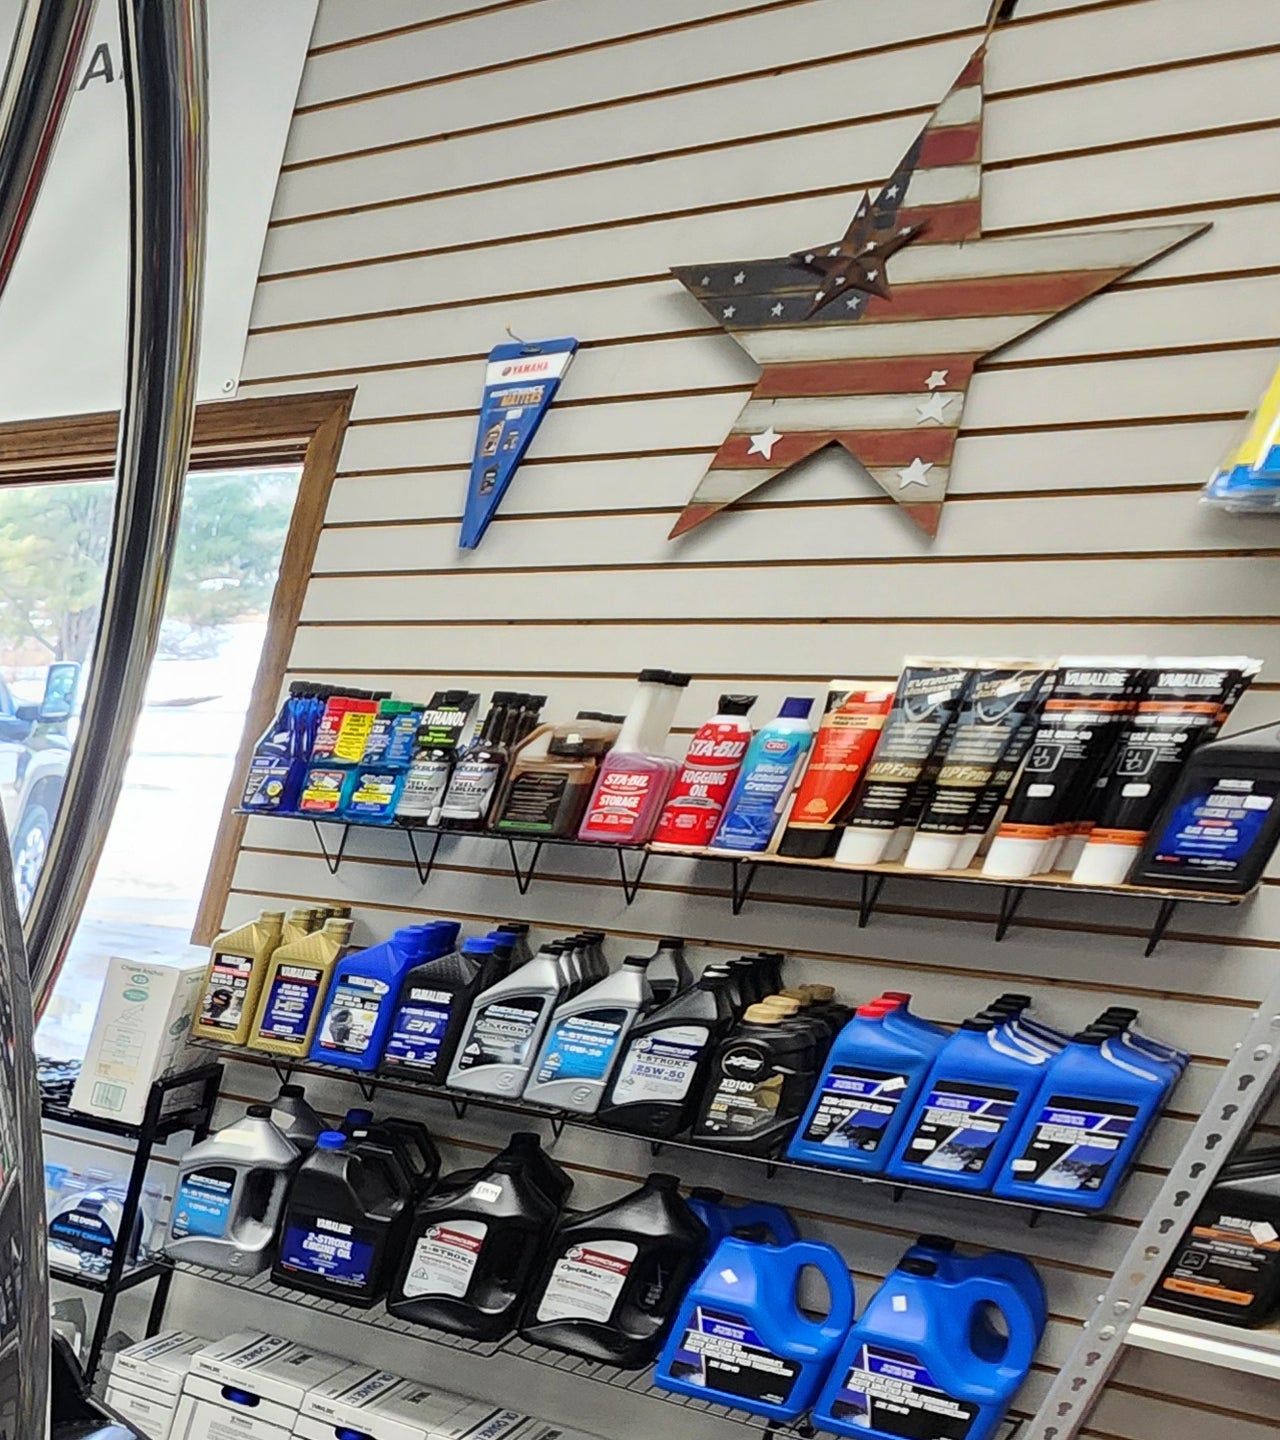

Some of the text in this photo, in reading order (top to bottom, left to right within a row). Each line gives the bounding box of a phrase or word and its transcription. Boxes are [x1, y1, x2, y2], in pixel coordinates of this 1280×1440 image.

[1064, 671, 1130, 687] YAMALUBE
[1157, 671, 1229, 688] YAMALUBE
[421, 710, 467, 727] ETHANOL
[688, 738, 746, 758] STA-BIL
[766, 741, 788, 750] CRC
[604, 773, 650, 788] STA-BIL
[681, 769, 728, 785] FOGGING
[689, 784, 709, 797] OIL
[598, 794, 641, 809] STORAGE
[636, 1053, 690, 1068] 4-STROKE
[636, 1064, 686, 1079] 25W-50
[720, 1077, 755, 1092] XD100
[52, 1224, 81, 1237] SAFETY
[316, 1217, 354, 1235] YAMALUBE
[307, 1232, 354, 1250] 2-STROKE
[302, 1239, 352, 1260] ENGINE OIL
